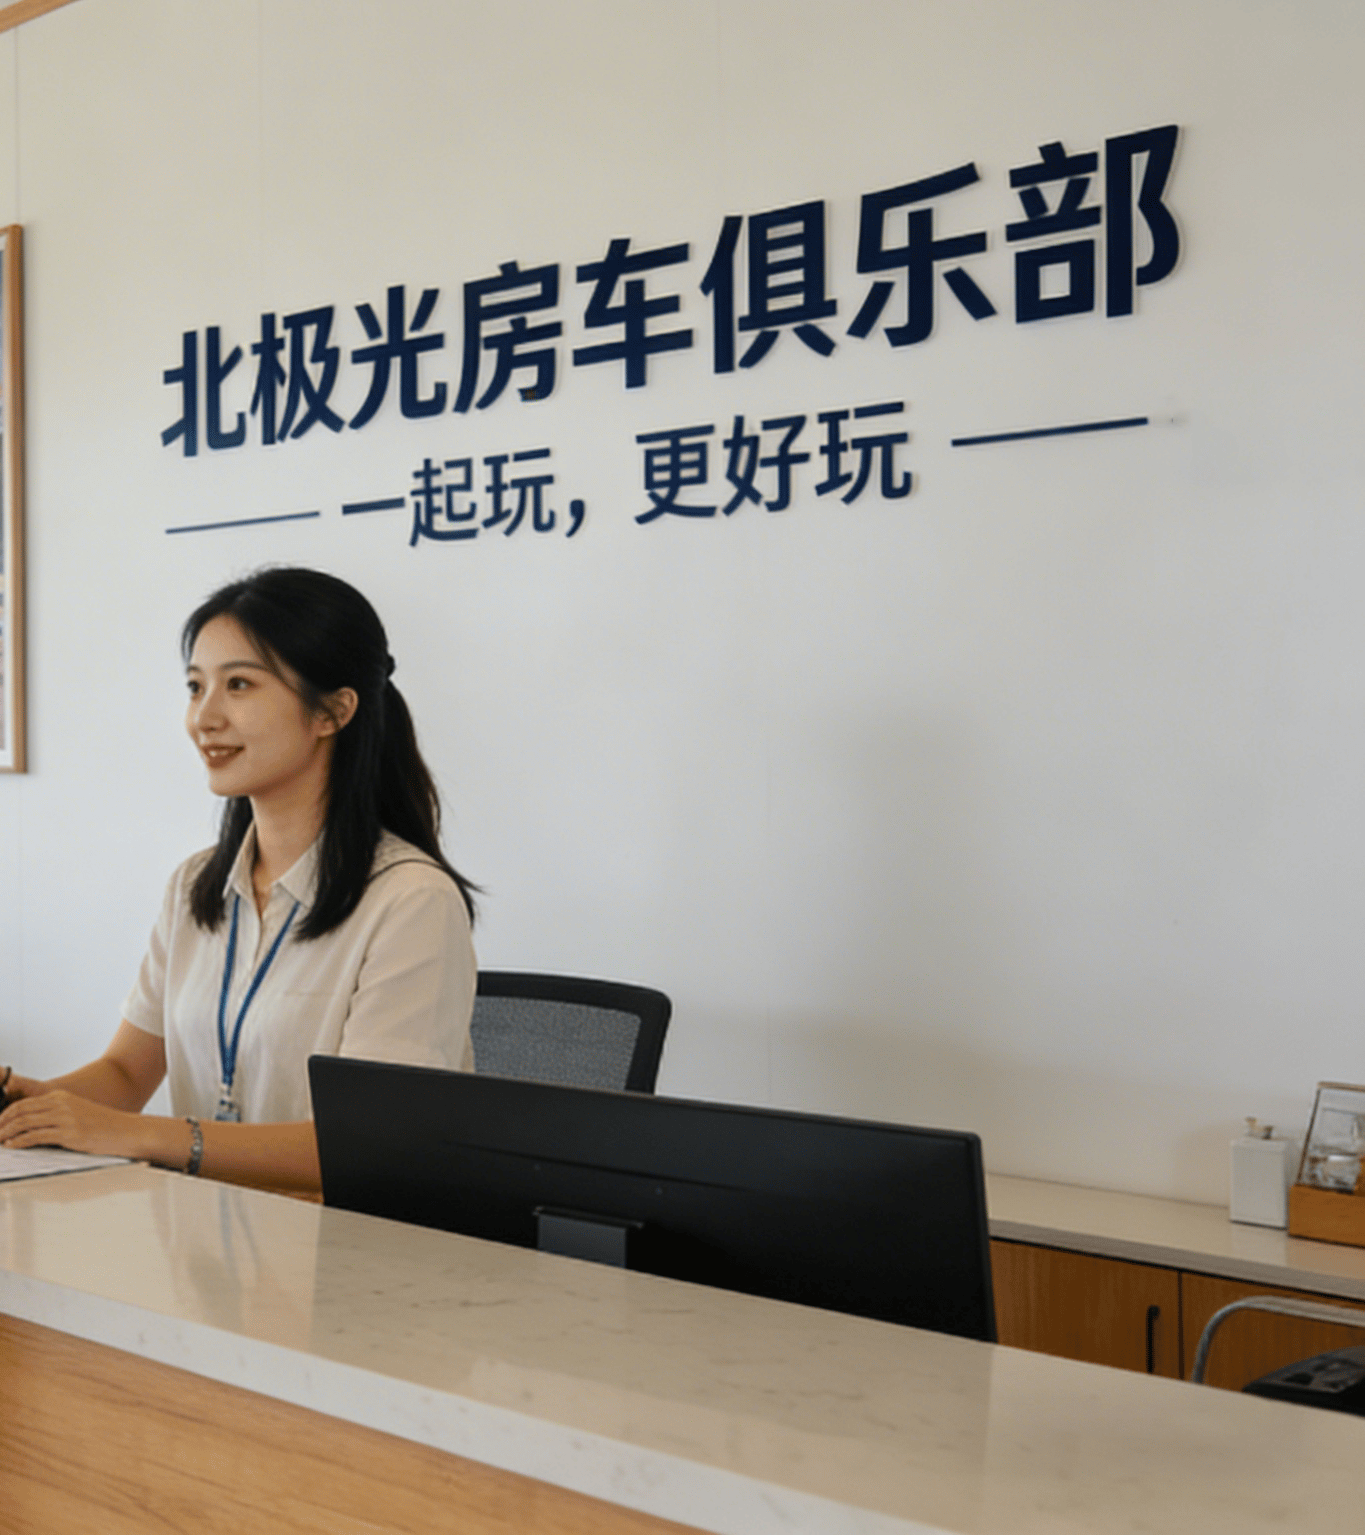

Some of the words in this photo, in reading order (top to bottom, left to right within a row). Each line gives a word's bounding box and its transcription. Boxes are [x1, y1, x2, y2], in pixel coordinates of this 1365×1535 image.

[161, 124, 1181, 457] 北极光房车俱乐部
[341, 401, 913, 547] 一起玩，更好玩
